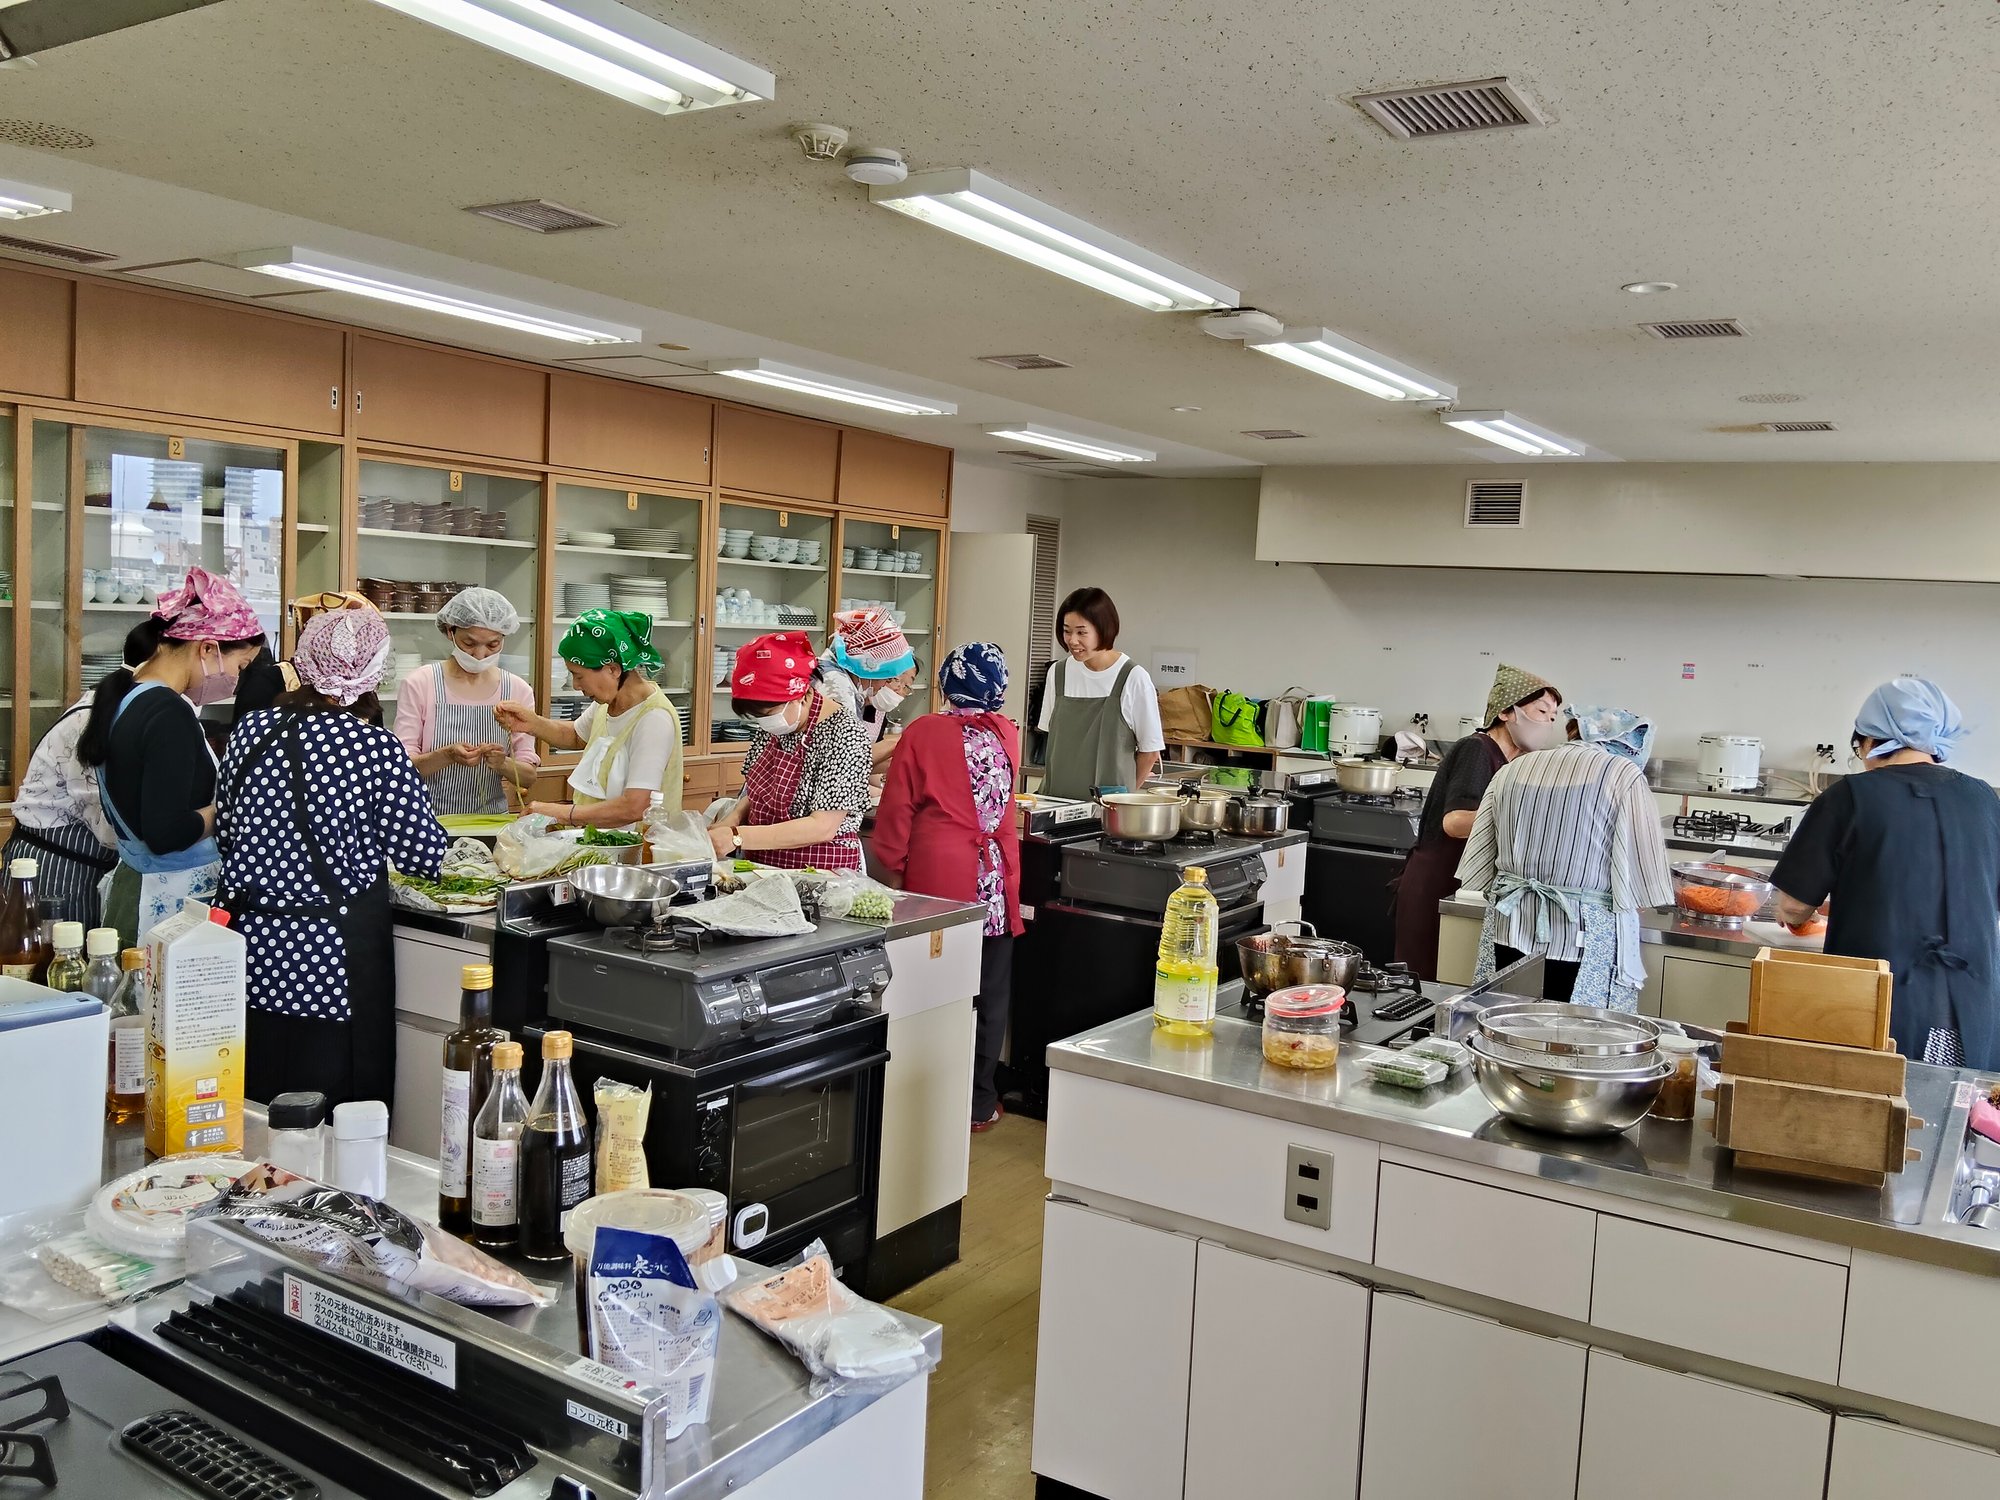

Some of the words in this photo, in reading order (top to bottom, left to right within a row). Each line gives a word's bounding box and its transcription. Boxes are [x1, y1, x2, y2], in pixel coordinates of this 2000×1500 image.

[173, 440, 181, 456] 2
[453, 475, 459, 488] 3
[1160, 664, 1186, 674] 荷物置き
[596, 1261, 632, 1271] 万能調味料
[632, 1253, 671, 1278] 寒こうじ
[290, 1283, 301, 1313] 注意
[657, 1335, 691, 1346] ドレッシング
[569, 1405, 615, 1432] コンロ元栓
